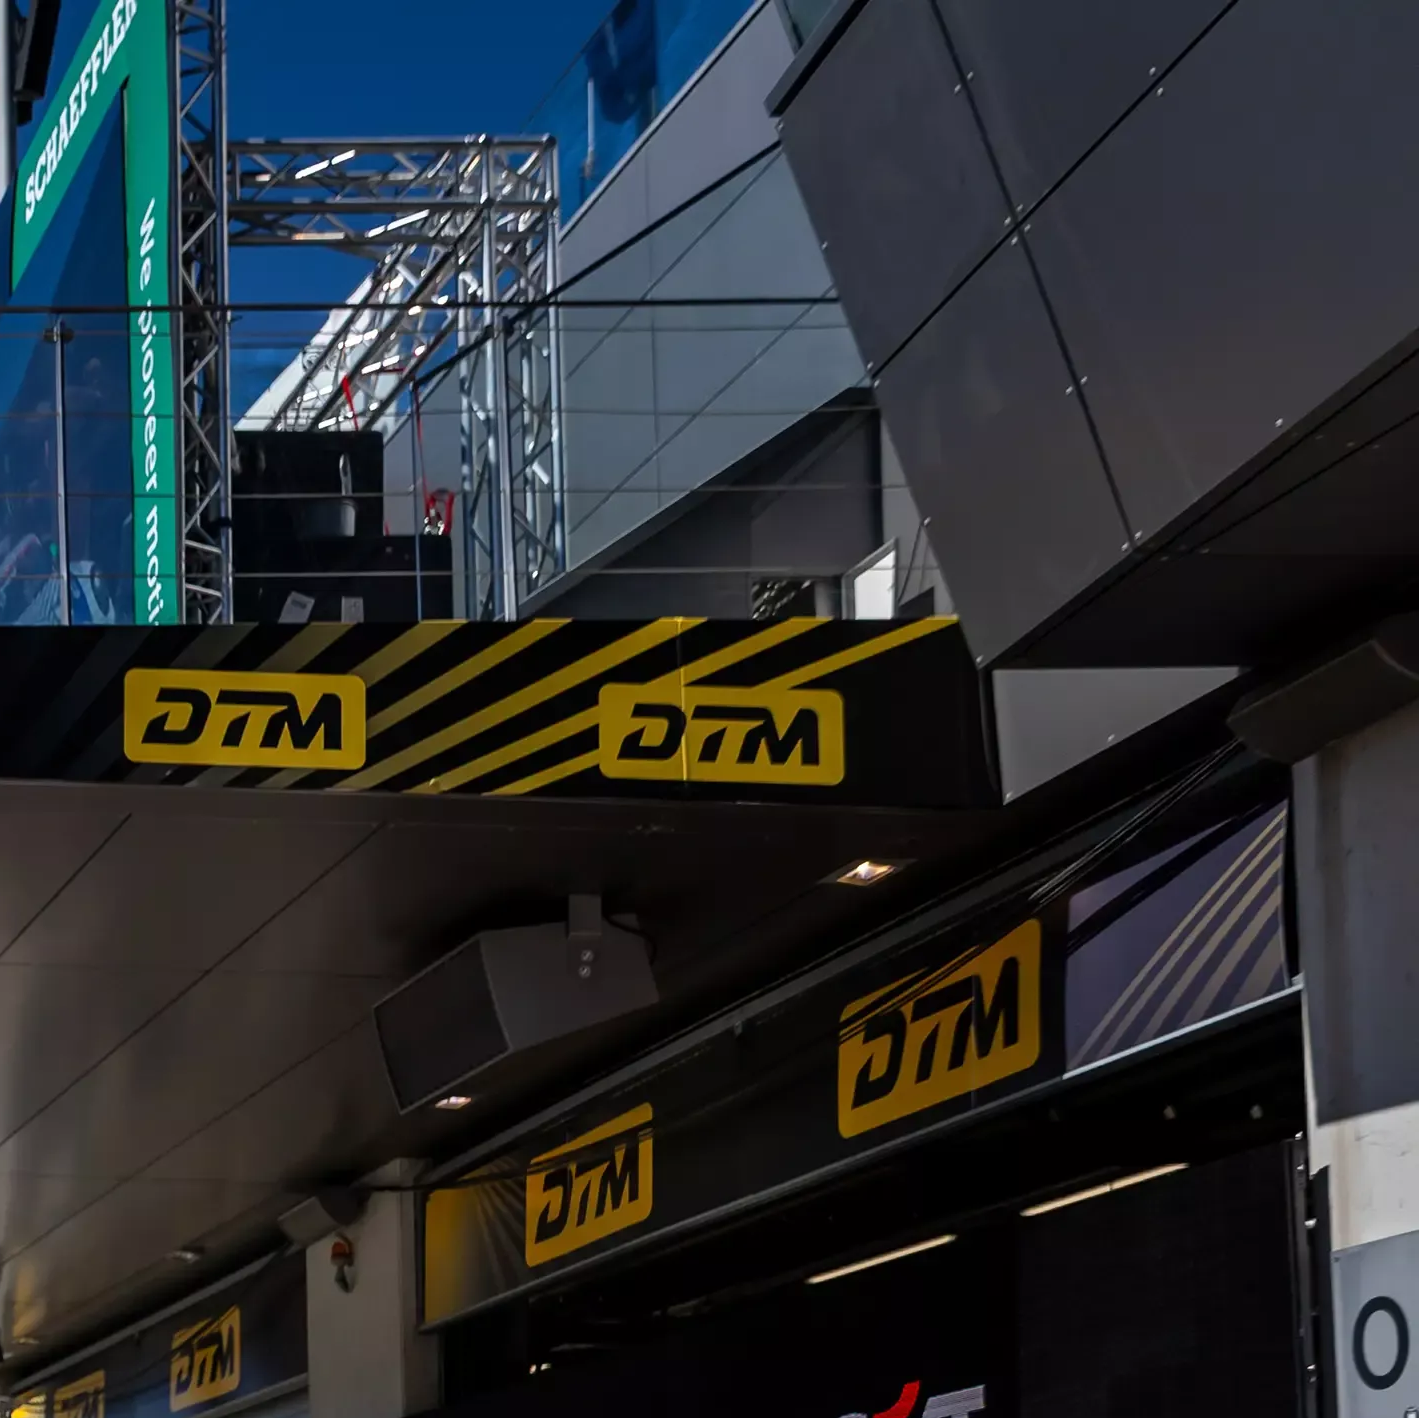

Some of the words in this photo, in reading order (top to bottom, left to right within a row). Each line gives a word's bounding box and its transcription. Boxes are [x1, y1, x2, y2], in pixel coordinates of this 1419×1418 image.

[25, 0, 138, 224] SCHAEFFLER
[139, 197, 155, 291] We
[137, 298, 160, 492] pioneer
[140, 687, 342, 751] DTM
[616, 703, 821, 767] DTM
[850, 956, 1022, 1111] DTM
[532, 1136, 641, 1248] DTM
[175, 1322, 237, 1397] DTM
[1352, 1296, 1410, 1391] 0
